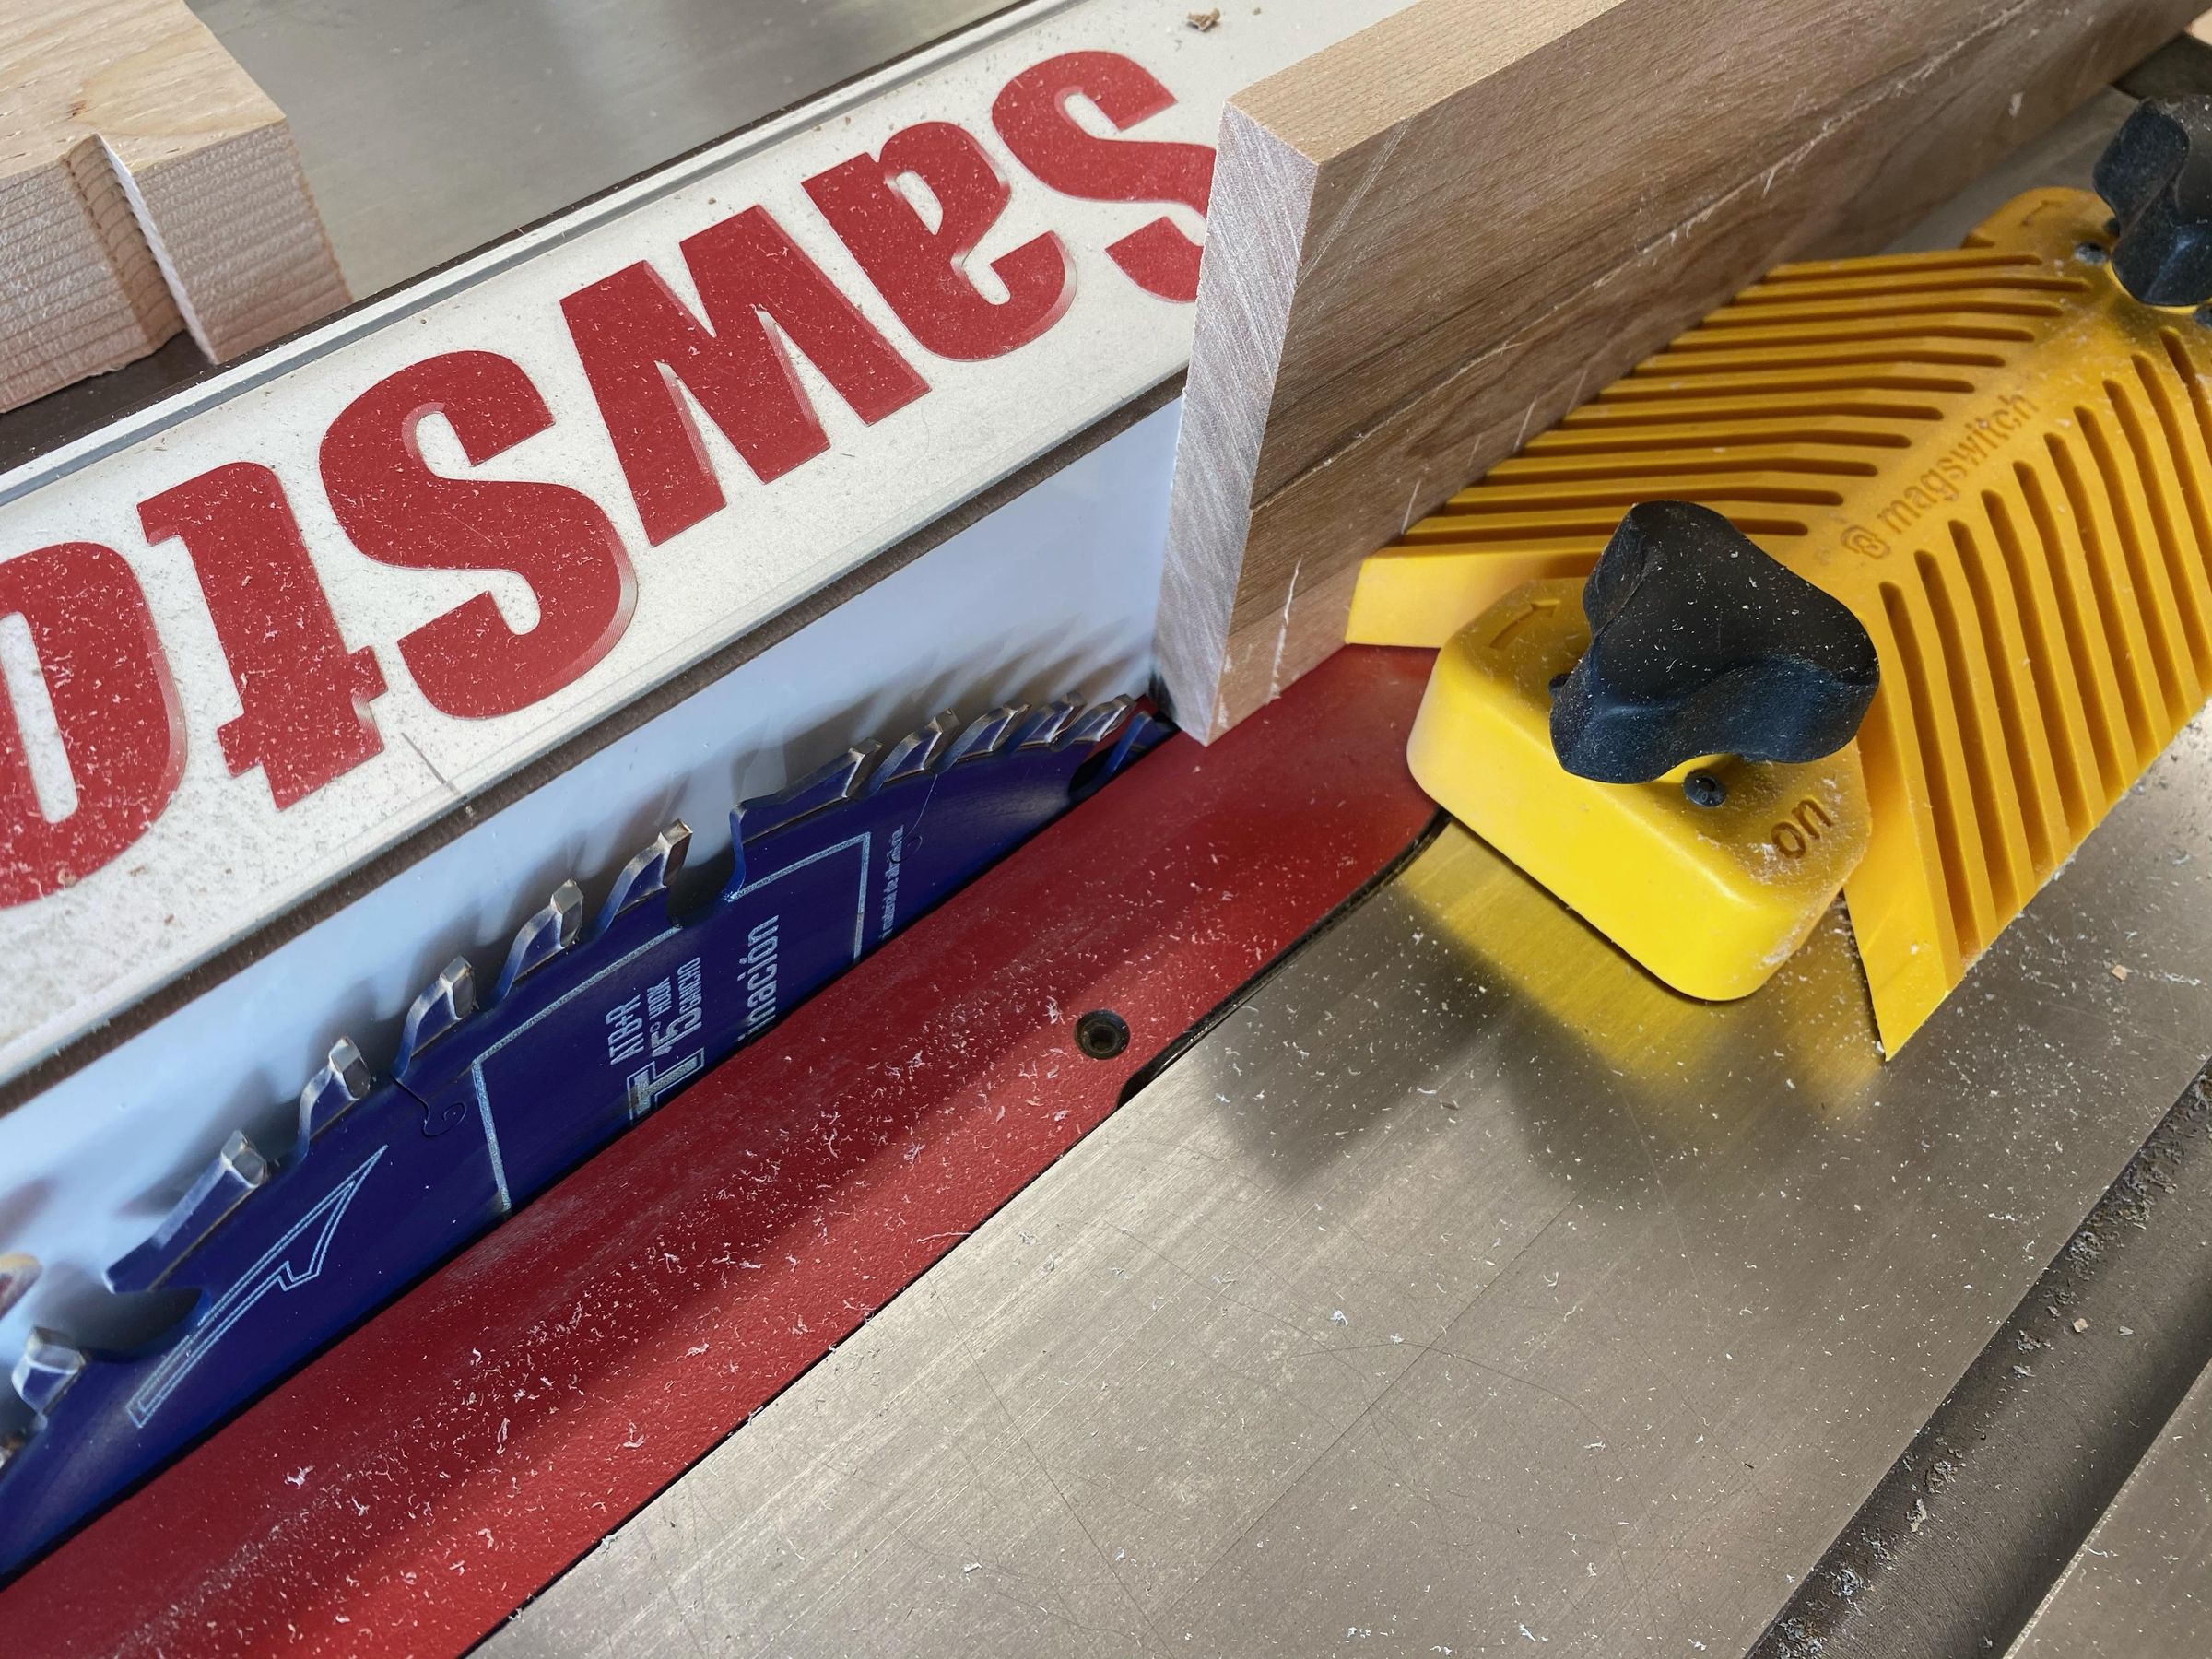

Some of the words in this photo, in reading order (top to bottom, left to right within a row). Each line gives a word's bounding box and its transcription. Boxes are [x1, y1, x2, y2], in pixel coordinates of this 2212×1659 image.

[1877, 394, 2039, 535] magswitch
[1771, 797, 1833, 859] on
[647, 976, 673, 1020] HOOK
[677, 957, 702, 1015] GANCHO
[606, 994, 644, 1065] ATB+R
